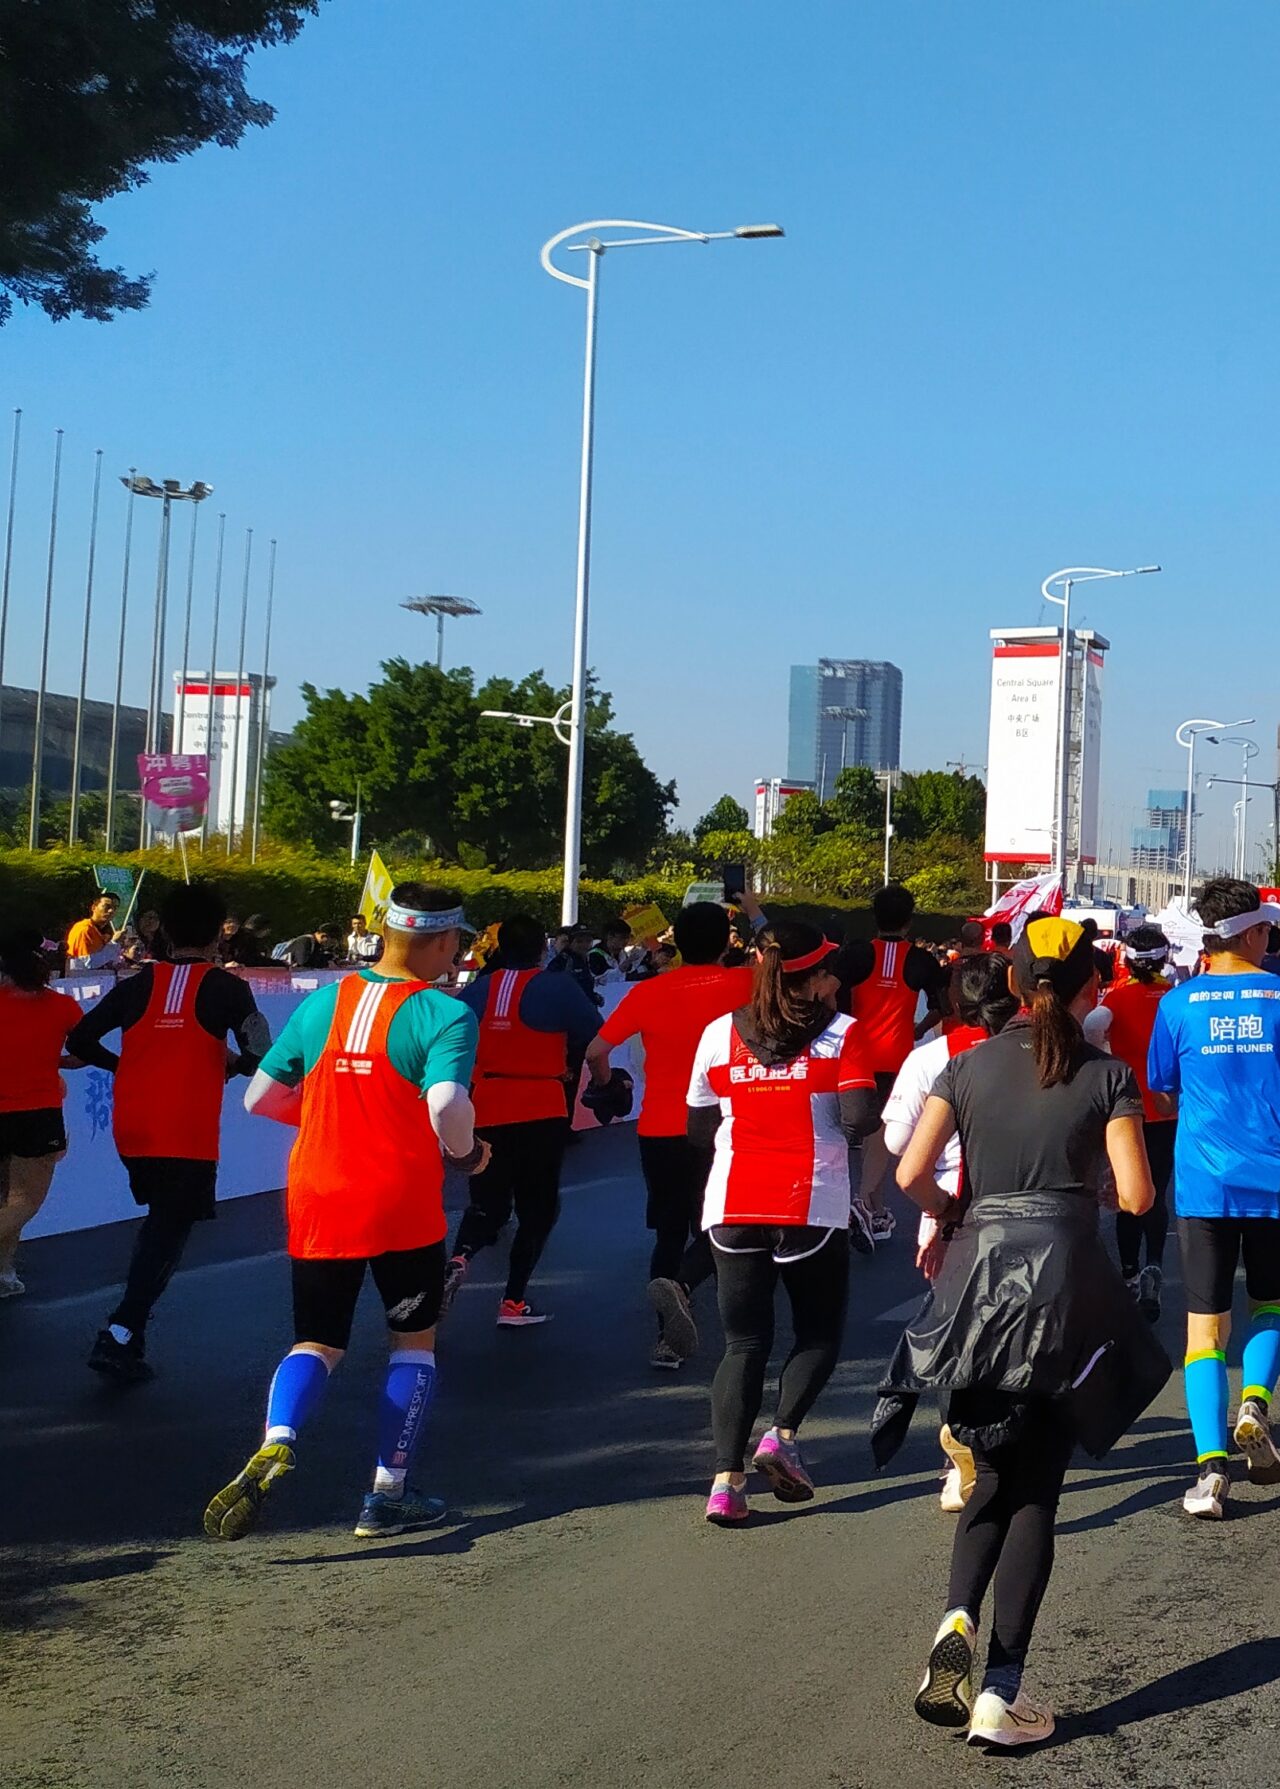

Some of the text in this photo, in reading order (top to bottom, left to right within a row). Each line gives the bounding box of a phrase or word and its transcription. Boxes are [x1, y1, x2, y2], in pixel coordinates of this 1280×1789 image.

[997, 678, 1054, 688] Central Square
[1011, 694, 1029, 703] Area
[1007, 713, 1040, 723] 中央广场
[1209, 1014, 1264, 1042] 陪跑
[1201, 1043, 1274, 1055] GUIDE RUNER
